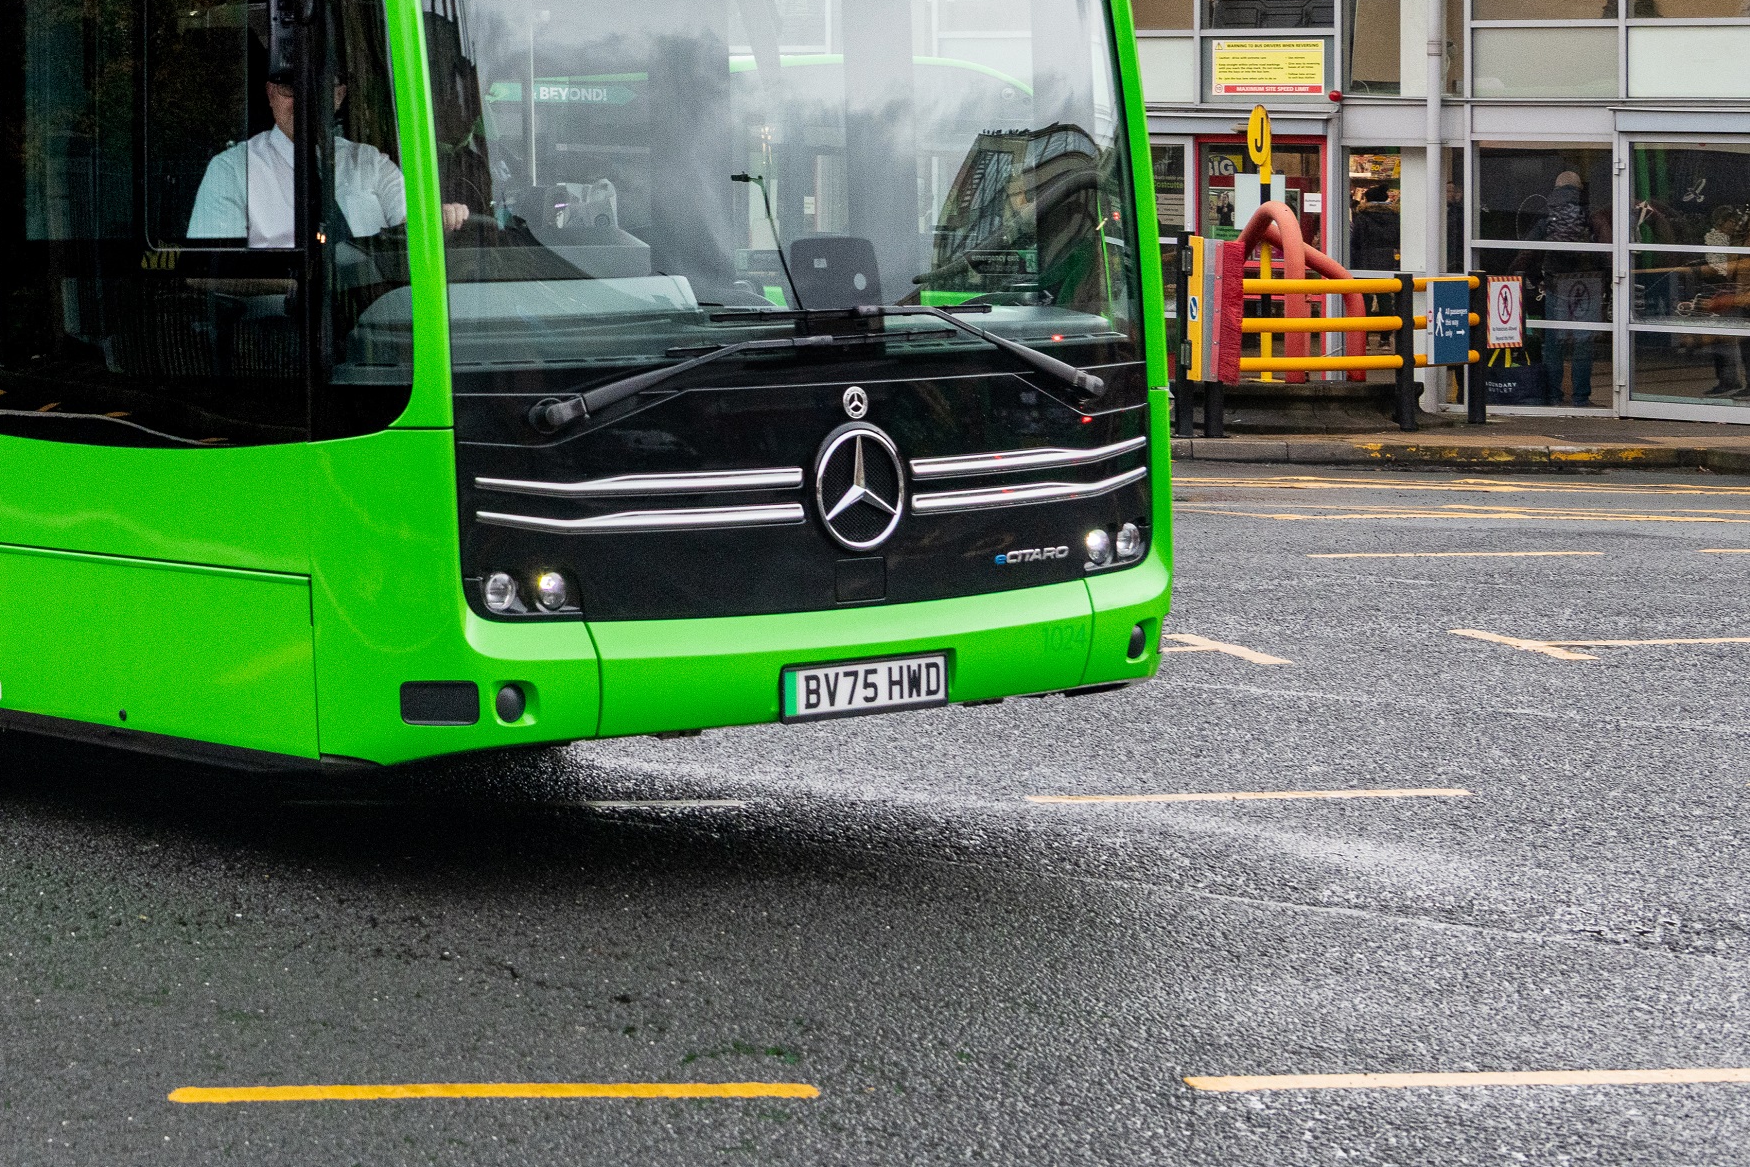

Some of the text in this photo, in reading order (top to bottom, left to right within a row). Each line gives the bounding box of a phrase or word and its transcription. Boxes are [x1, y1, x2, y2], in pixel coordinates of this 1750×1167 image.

[540, 86, 607, 101] BEYOND!
[1255, 117, 1264, 152] J
[994, 546, 1069, 565] eCITARO
[804, 662, 940, 710] BV75 HWD
